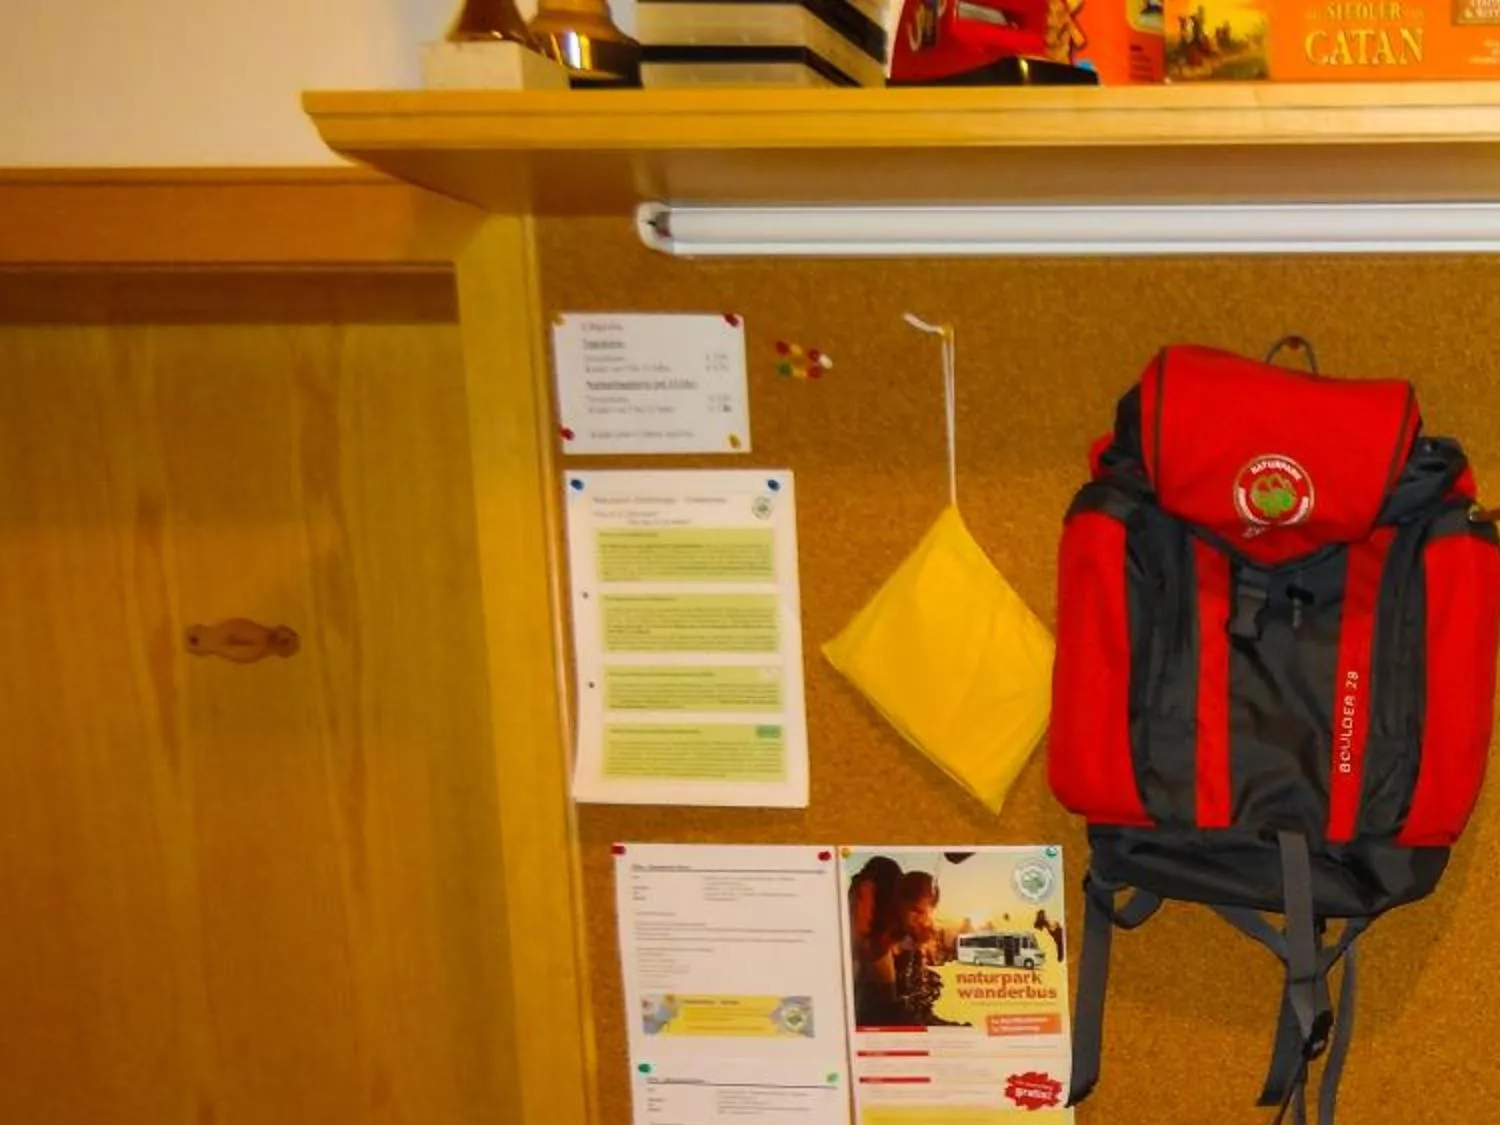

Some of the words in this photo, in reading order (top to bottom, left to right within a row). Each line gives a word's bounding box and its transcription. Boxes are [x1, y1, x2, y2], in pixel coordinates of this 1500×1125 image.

[1305, 28, 1423, 65] CATAN
[1339, 695, 1356, 773] BOULDER
[956, 971, 1042, 989] naturpark
[957, 987, 1057, 999] wanderbus
